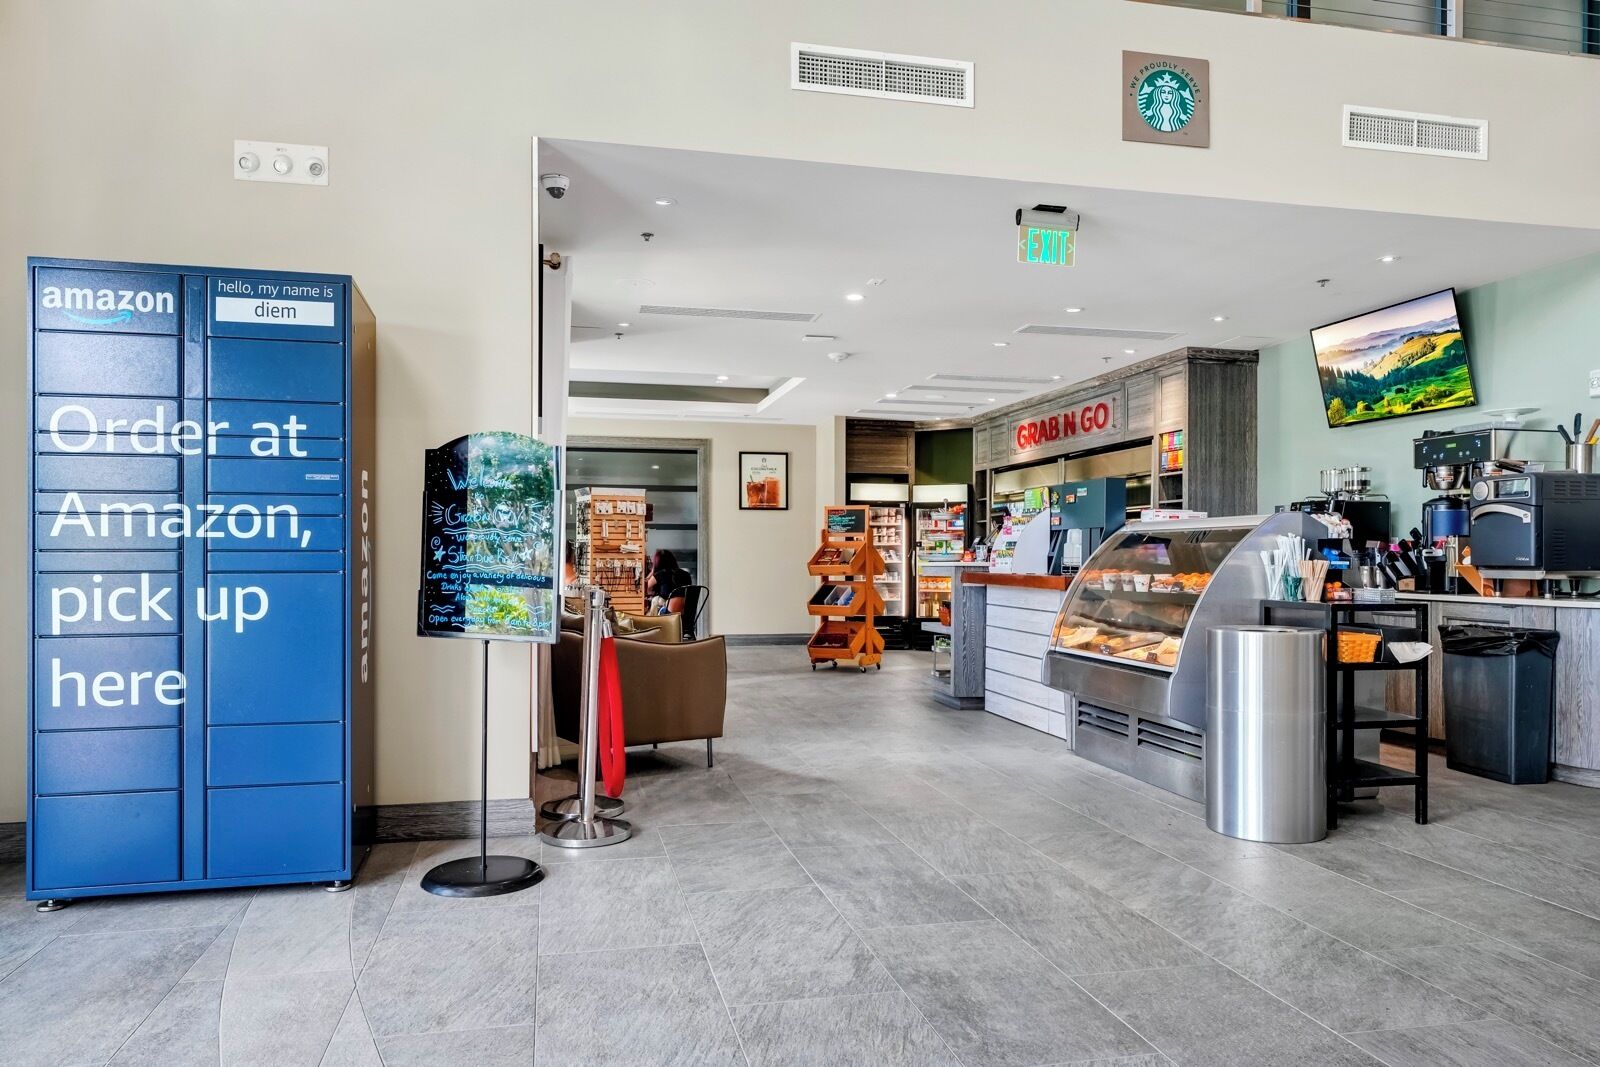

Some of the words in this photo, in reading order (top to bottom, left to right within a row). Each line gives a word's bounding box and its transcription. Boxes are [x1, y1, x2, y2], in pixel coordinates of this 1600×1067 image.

[1129, 75, 1139, 89] WE
[1139, 61, 1178, 76] PROUDLY
[1180, 68, 1201, 94] SERVE
[1027, 227, 1069, 265] EXIT
[42, 286, 175, 314] amazon
[218, 279, 254, 296] hello,
[258, 285, 279, 298] my
[283, 286, 320, 297] name
[324, 285, 333, 298] is
[254, 301, 297, 319] diem
[49, 404, 229, 456] Order
[250, 414, 308, 457] at
[1017, 415, 1060, 447] GRAB
[1080, 402, 1109, 433] GO
[50, 492, 312, 547] Amazon,
[361, 469, 369, 684] amazon
[427, 571, 447, 580] Come
[450, 572, 472, 584] enjoy
[480, 572, 505, 583] variety
[516, 573, 546, 583] delicious
[52, 572, 173, 635] pick
[197, 583, 269, 633] up
[428, 614, 448, 625] Open
[451, 616, 485, 626] everyday
[52, 658, 186, 708] here
